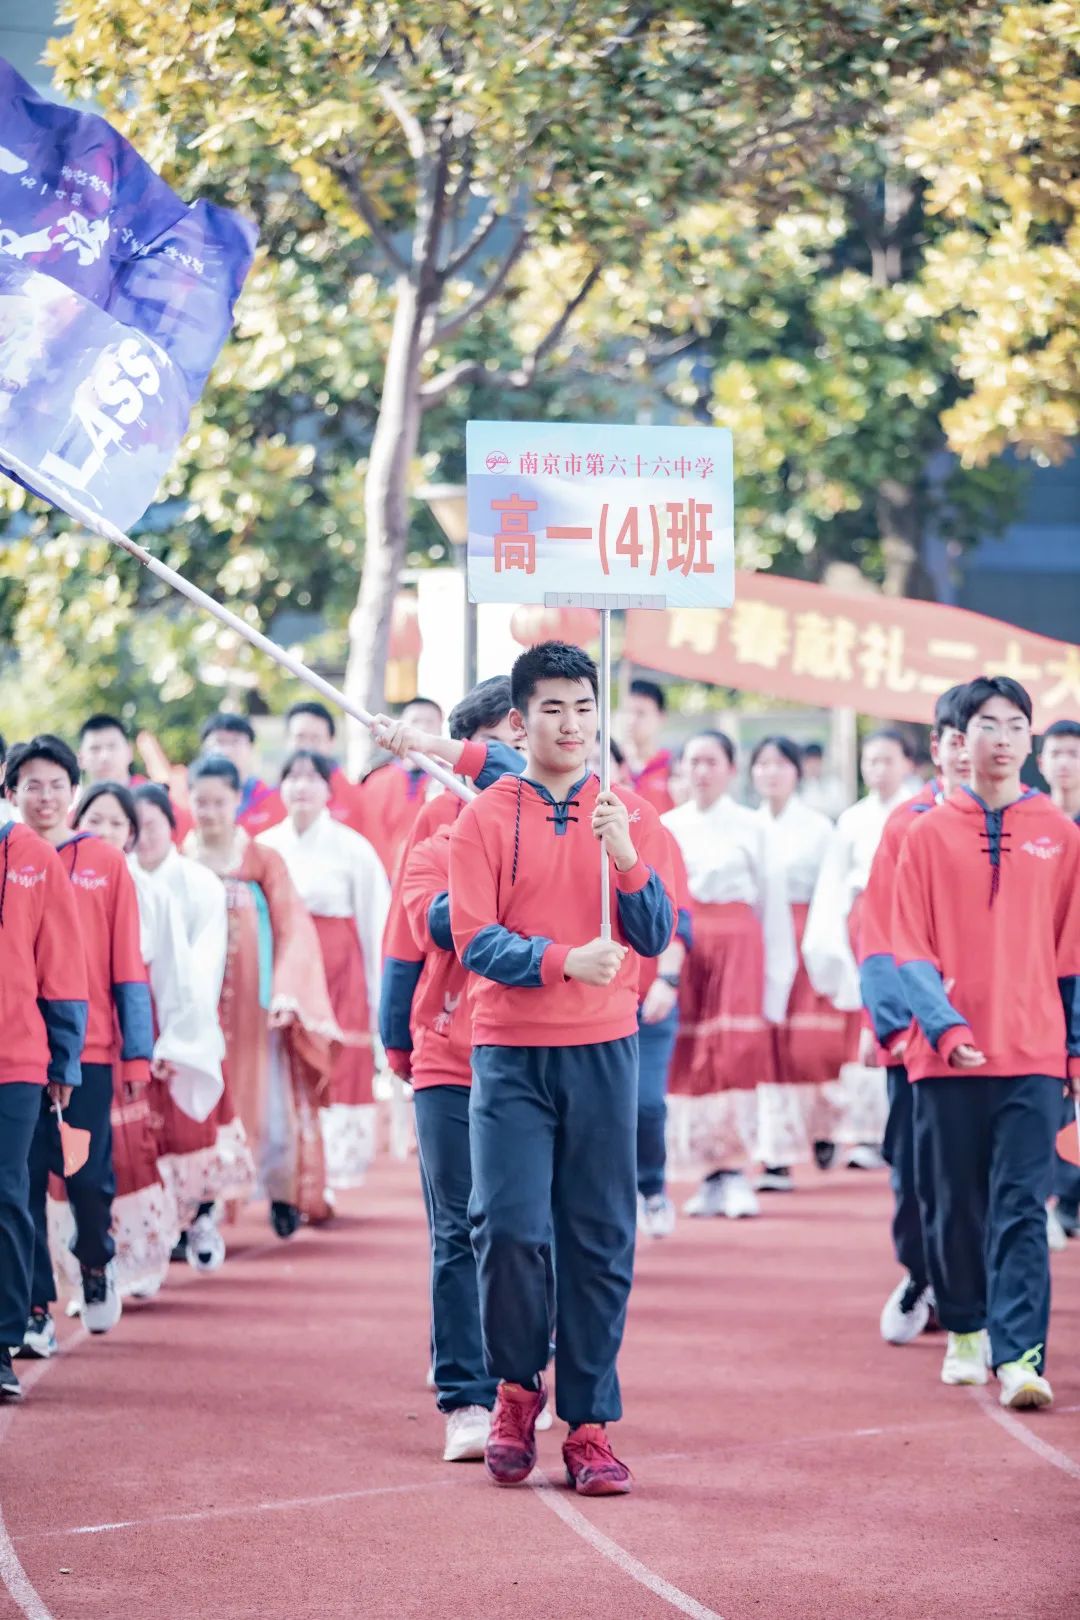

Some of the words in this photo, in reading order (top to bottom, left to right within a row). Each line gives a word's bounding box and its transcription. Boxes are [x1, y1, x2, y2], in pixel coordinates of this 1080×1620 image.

[519, 451, 715, 480] 南京市第六十六中学
[490, 493, 715, 577] 高一(4)班
